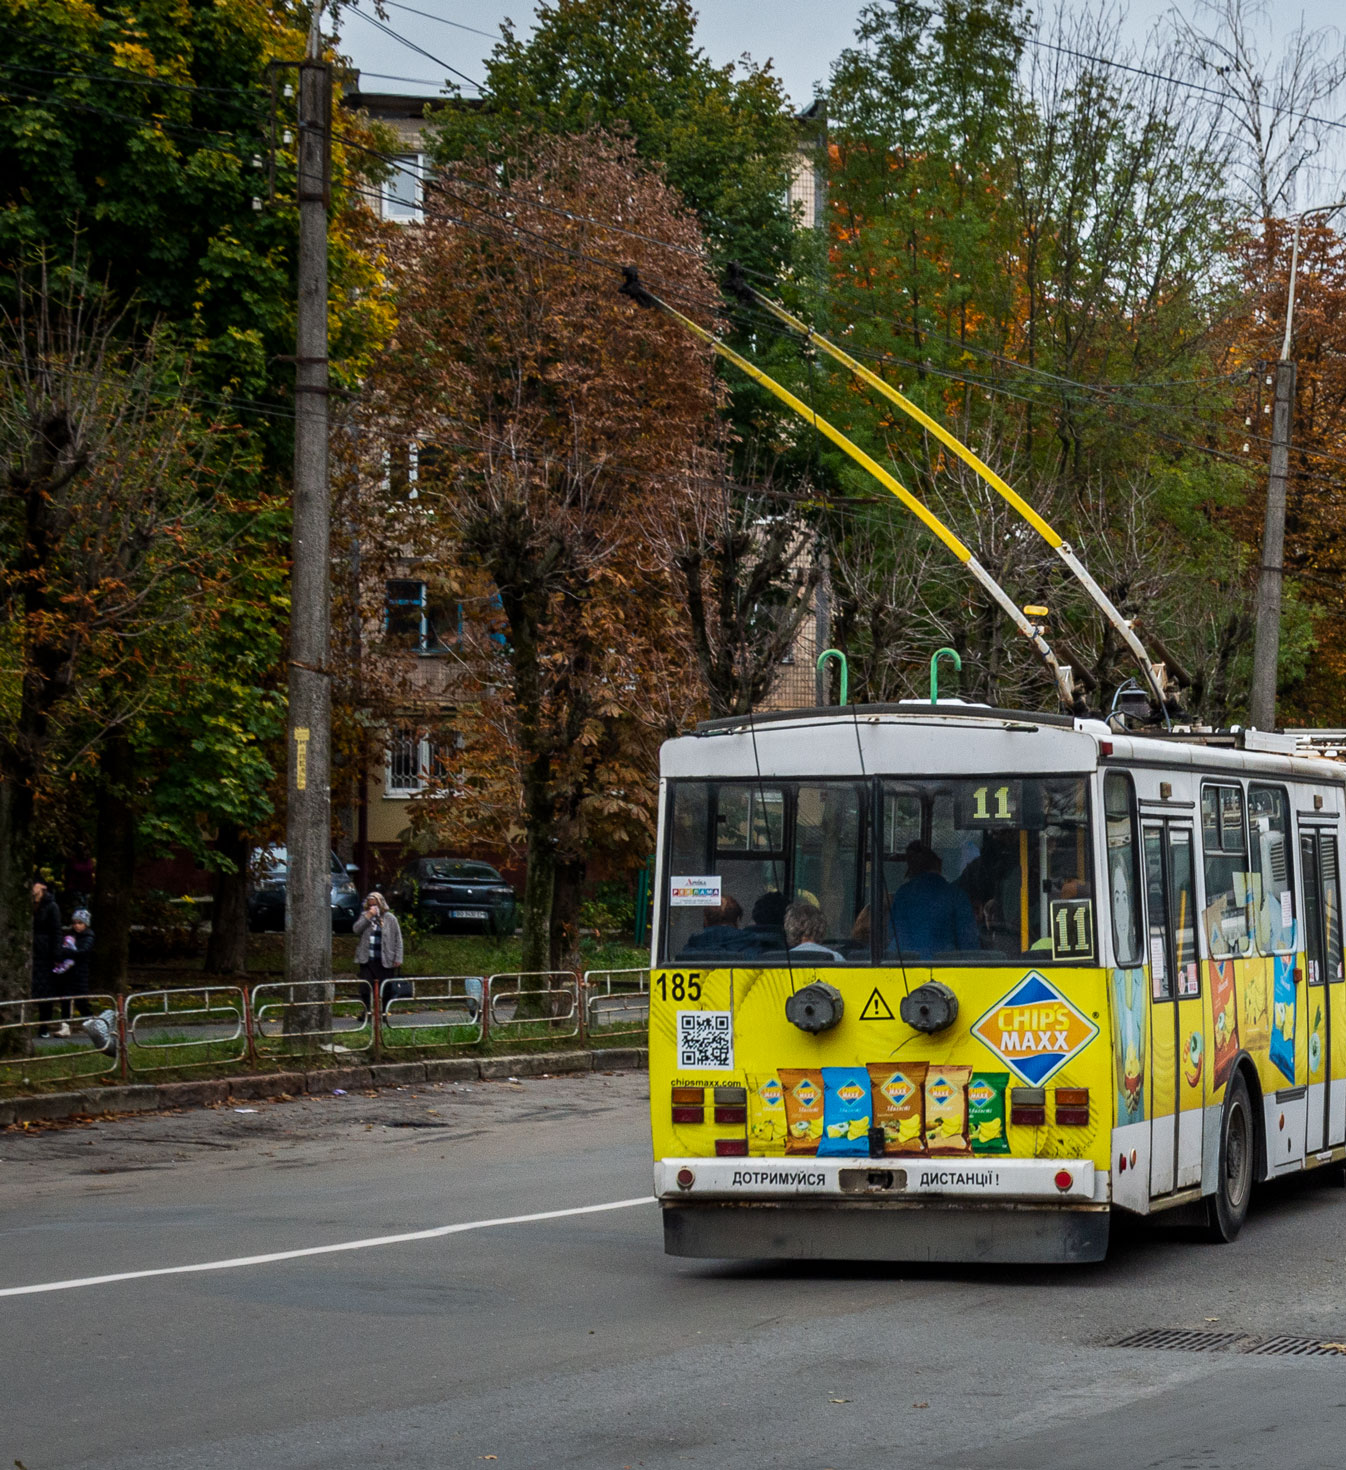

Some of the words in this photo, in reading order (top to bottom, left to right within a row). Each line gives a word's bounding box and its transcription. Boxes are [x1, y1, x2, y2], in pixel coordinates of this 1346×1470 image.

[973, 786, 1012, 819] 11
[1055, 906, 1090, 952] 11
[656, 972, 702, 1002] 185
[997, 1004, 1071, 1032] CHIP'S
[999, 1031, 1070, 1051] MAXX
[670, 1078, 742, 1088] chipsmaxx.com
[731, 1170, 826, 1187] ДОТРИМУЙСЯ
[920, 1170, 993, 1188] ДИСТАНЦІЇ
